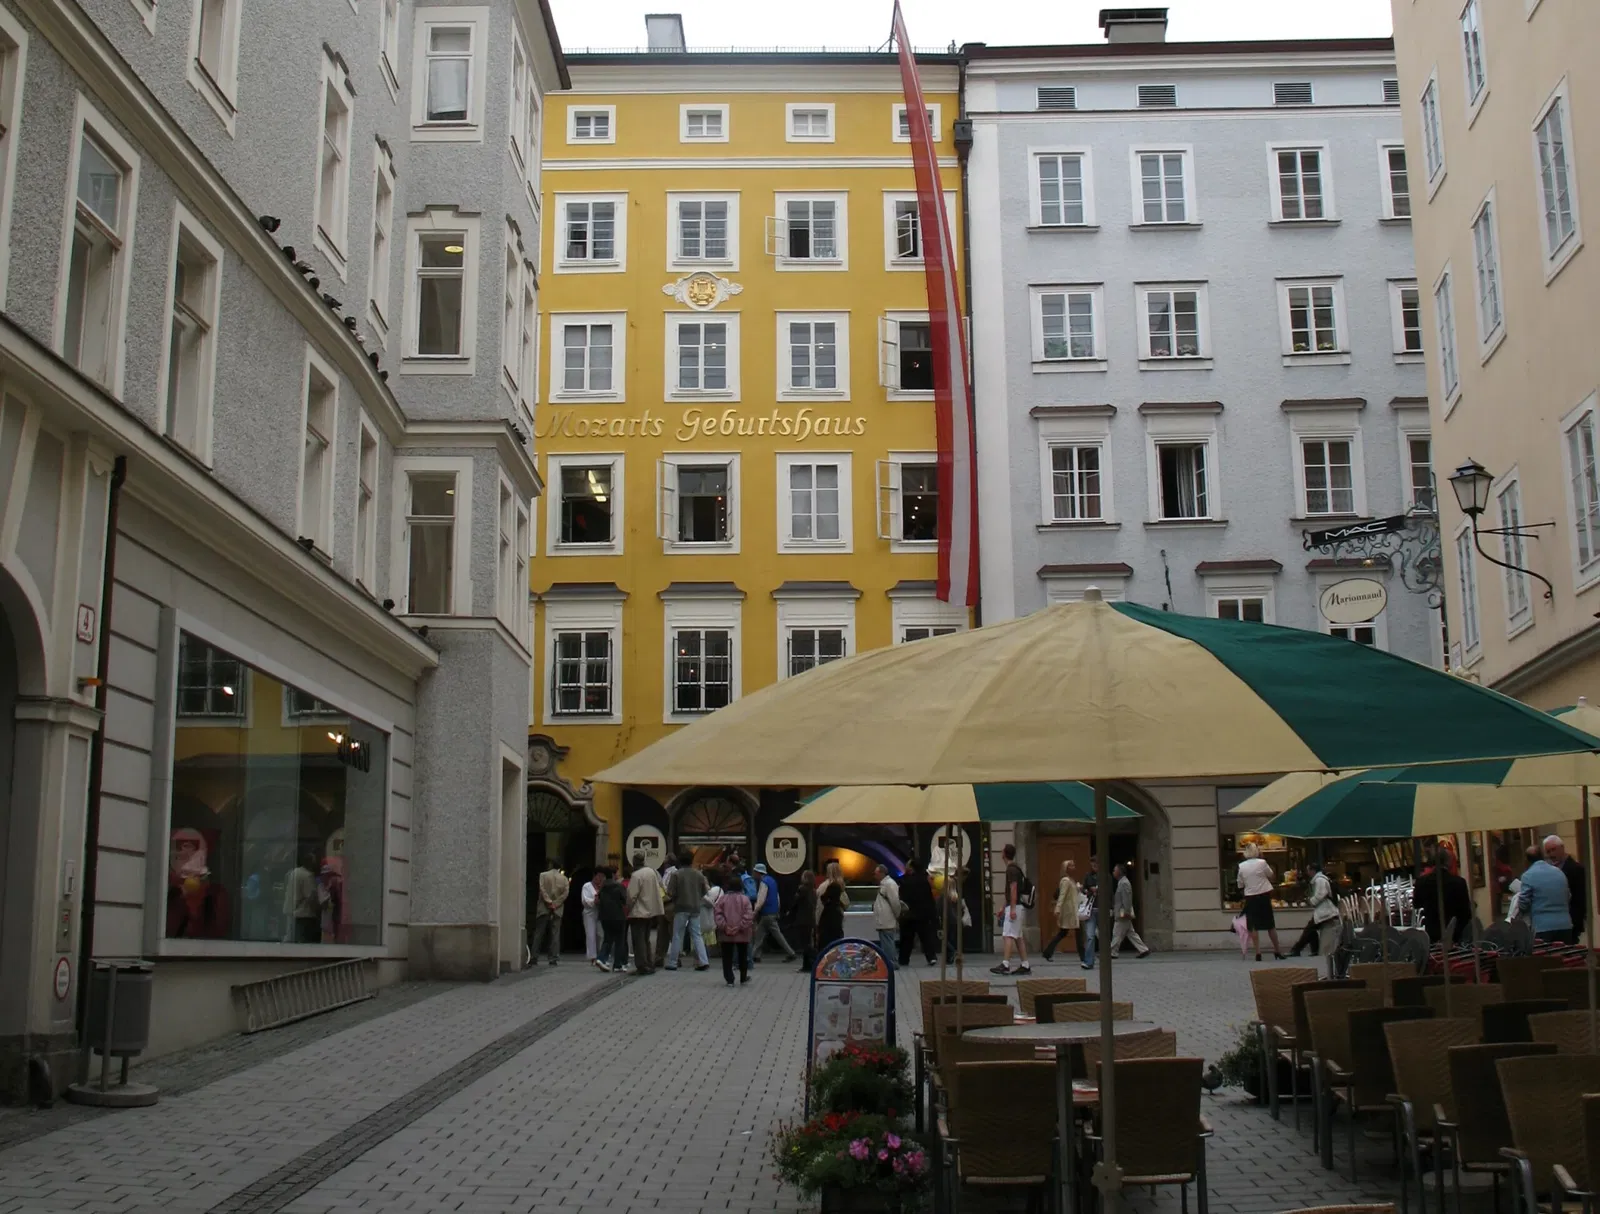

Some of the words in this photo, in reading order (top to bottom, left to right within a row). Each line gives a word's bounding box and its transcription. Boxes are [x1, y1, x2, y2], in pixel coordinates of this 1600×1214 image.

[534, 409, 665, 438] Mozarts
[675, 407, 867, 442] Geburtshaus
[1325, 589, 1383, 609] Marionnaud
